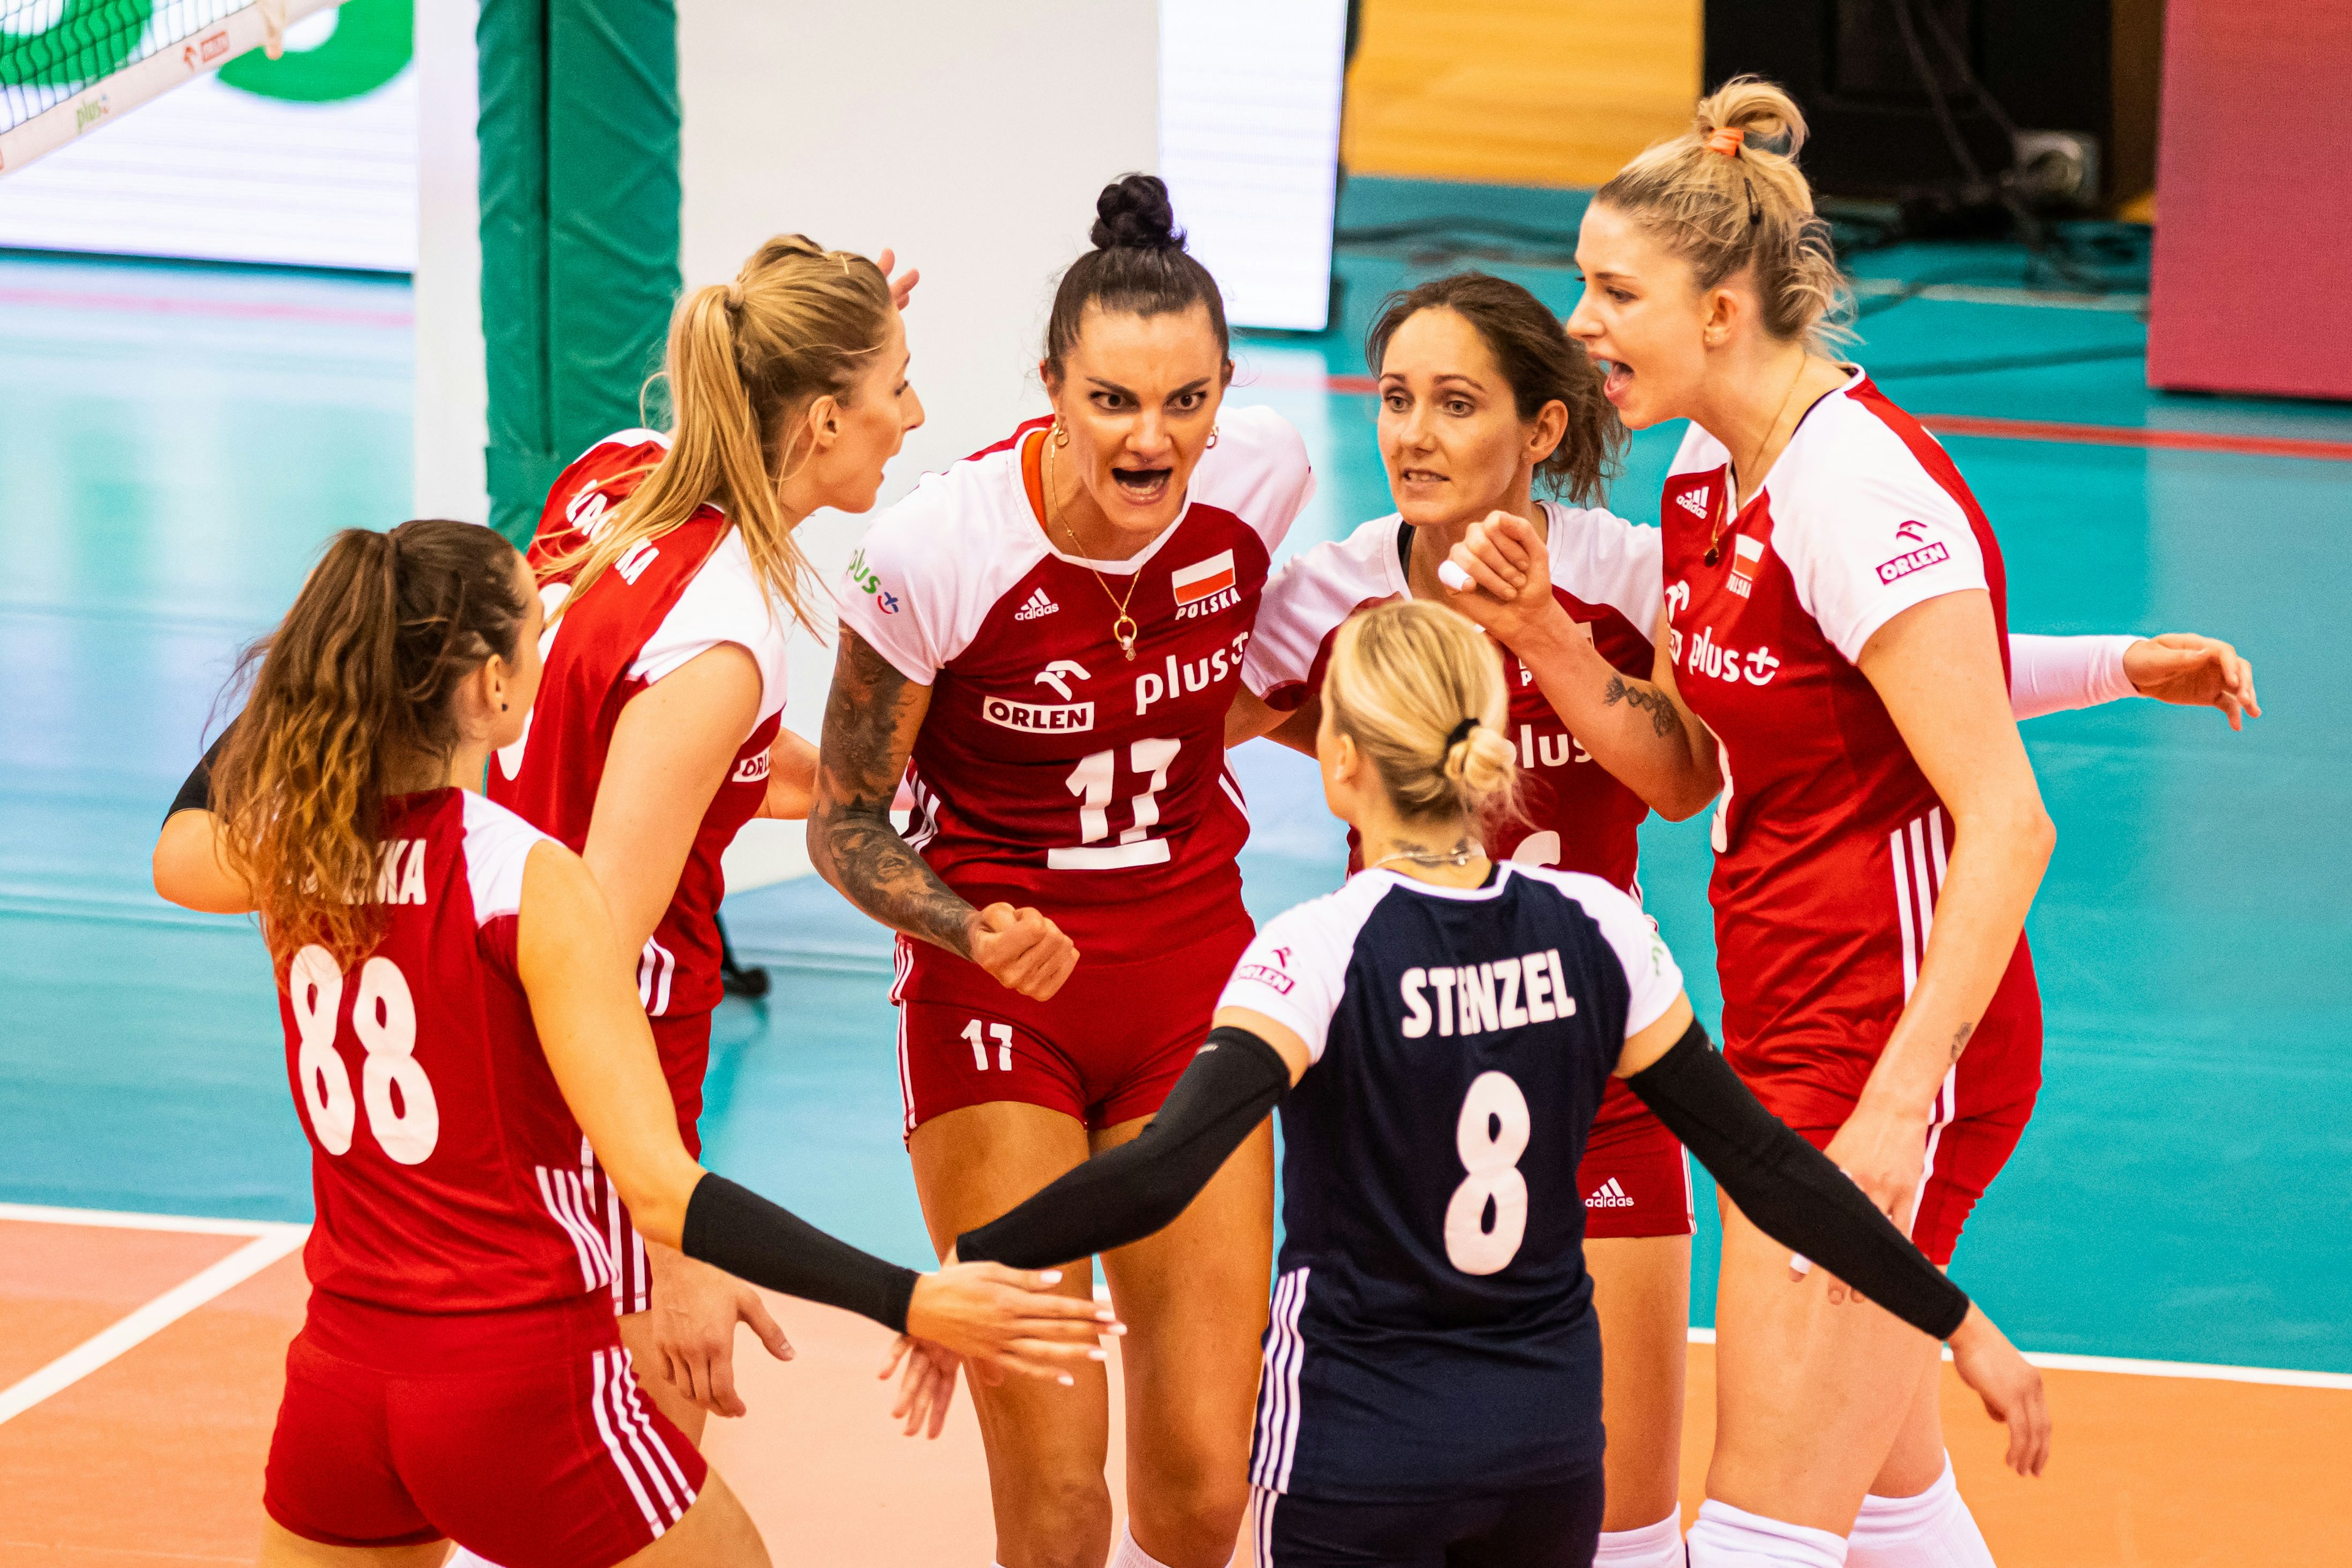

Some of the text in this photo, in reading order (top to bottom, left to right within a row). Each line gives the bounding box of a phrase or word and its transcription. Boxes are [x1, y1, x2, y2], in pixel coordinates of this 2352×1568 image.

[1676, 495, 1708, 519] adidas
[1880, 544, 1948, 581] ORLEN
[1014, 603, 1059, 620] adidas
[1175, 587, 1242, 620] POLSKA
[1688, 626, 1740, 682] plus
[1136, 649, 1228, 715] plus
[989, 701, 1088, 730] ORLEN
[741, 753, 768, 778] ORL
[1065, 738, 1181, 845] 17
[1400, 948, 1577, 1038] STENZEL
[290, 944, 440, 1166] 88
[960, 1019, 1012, 1071] 17
[1444, 1070, 1531, 1276] 8
[1585, 1195, 1635, 1208] adidas
